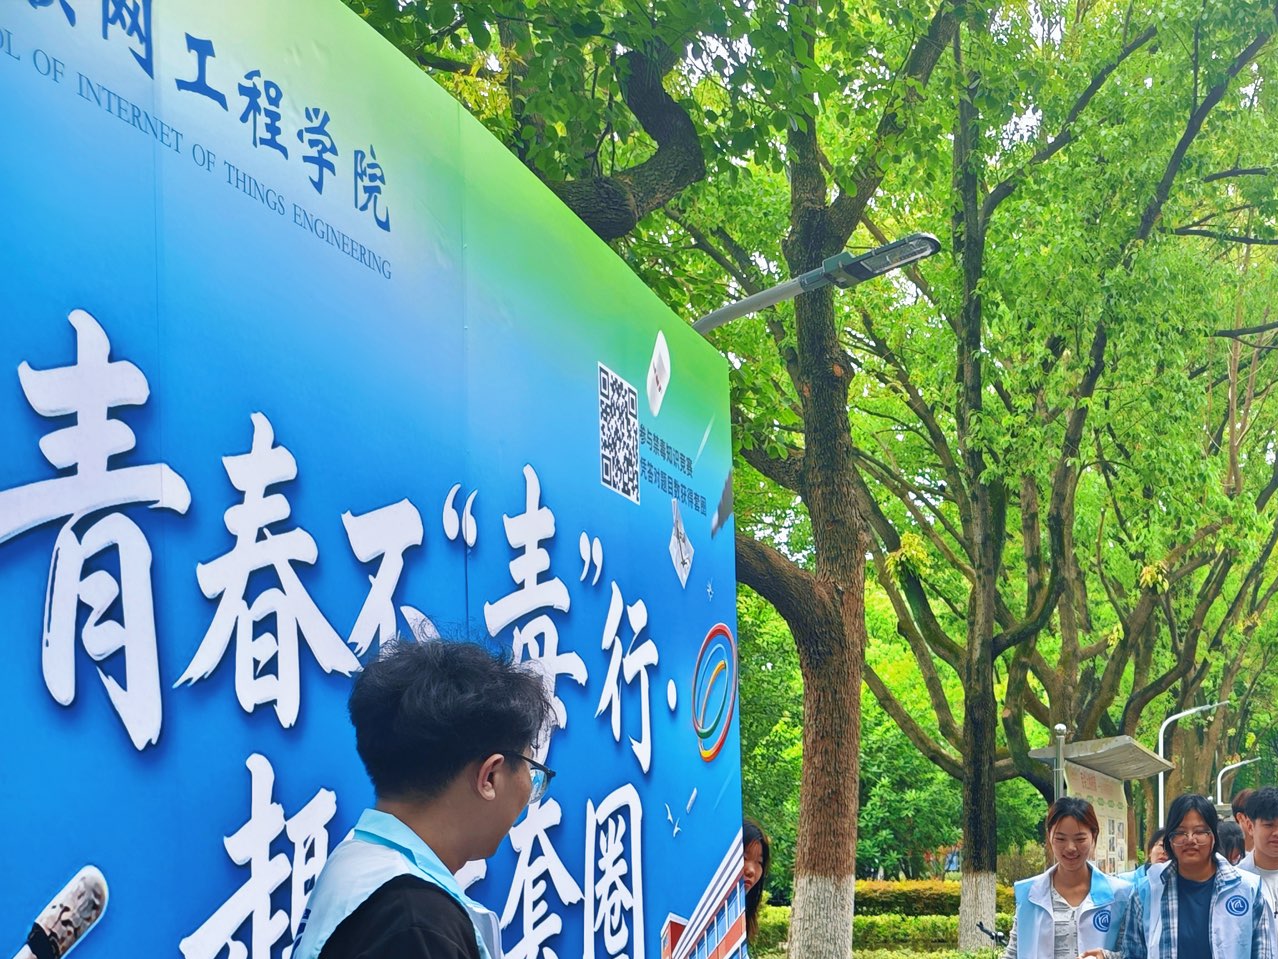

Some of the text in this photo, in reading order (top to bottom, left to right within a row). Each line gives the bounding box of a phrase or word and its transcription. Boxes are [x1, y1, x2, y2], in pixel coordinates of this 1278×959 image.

[27, 0, 391, 233] 网工程学院
[32, 48, 65, 84] OF
[76, 71, 184, 154] INTERNET
[192, 142, 216, 173] OF
[223, 159, 286, 216] THINGS
[292, 202, 392, 280] ENGINEERING
